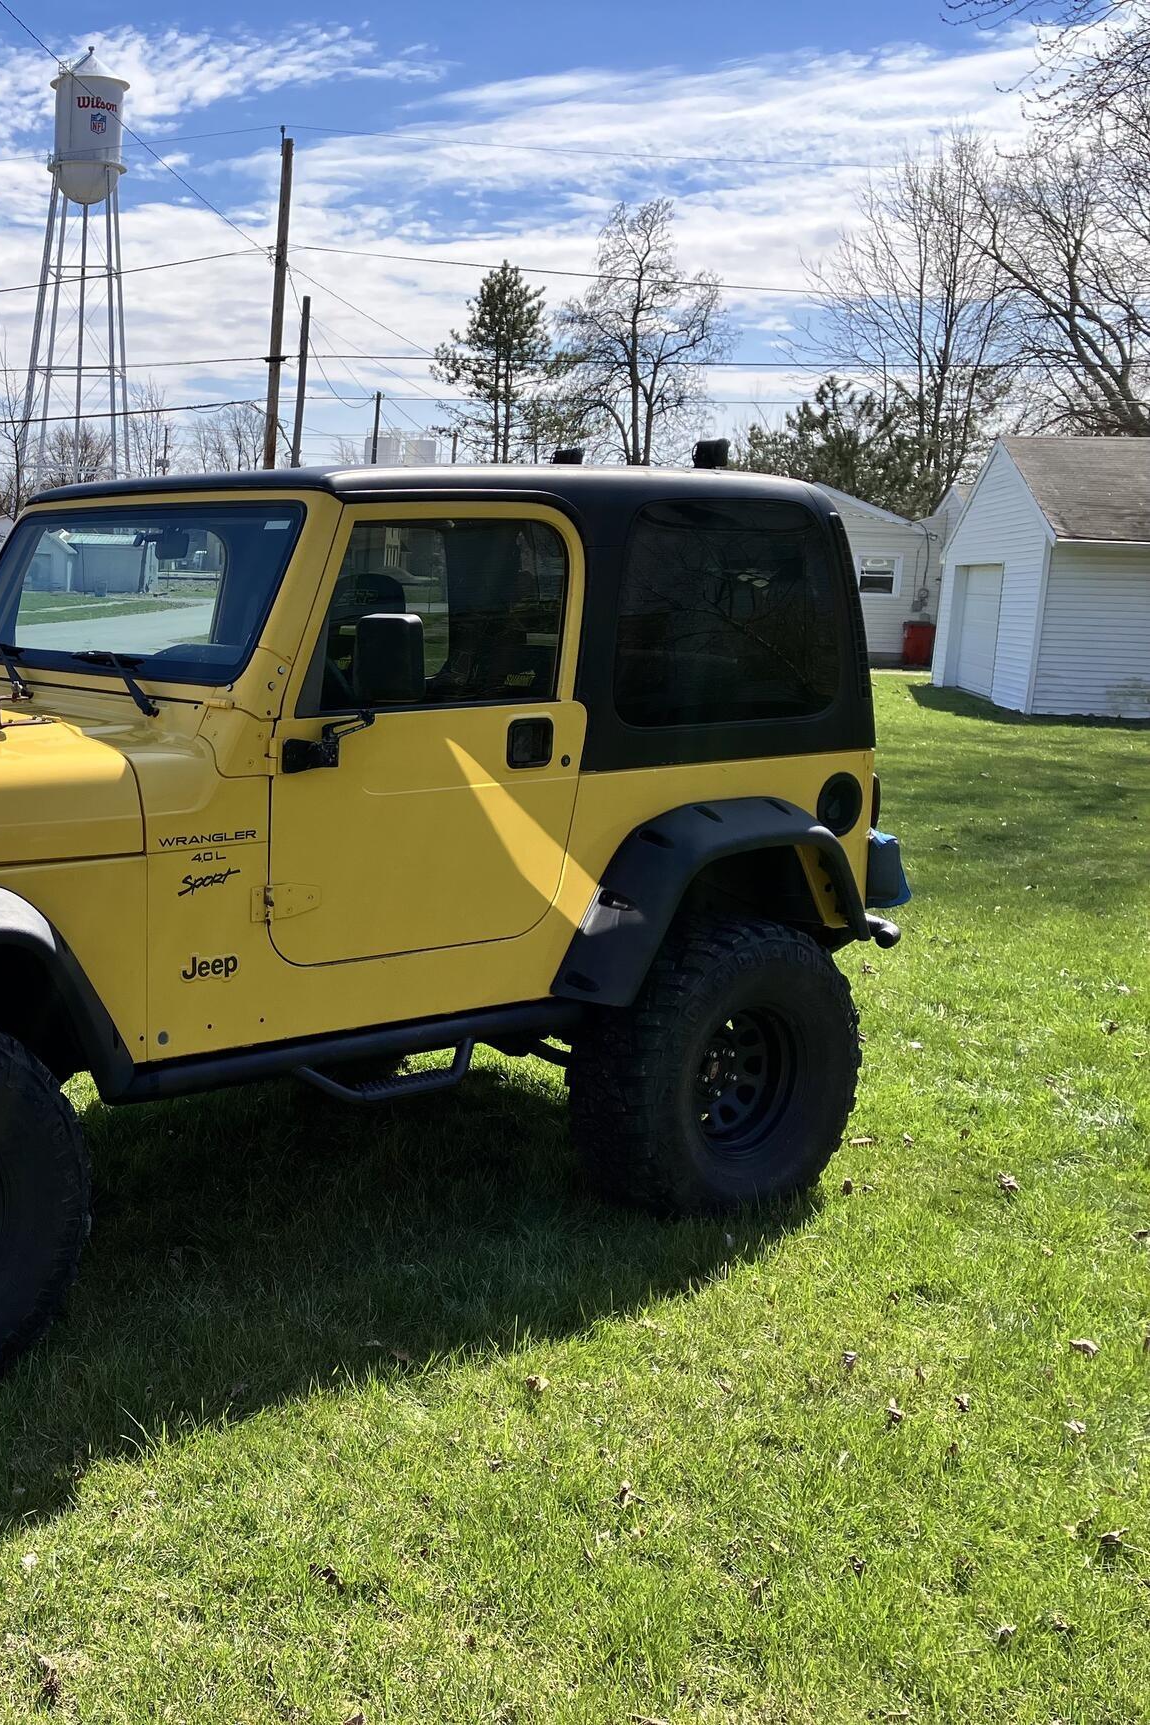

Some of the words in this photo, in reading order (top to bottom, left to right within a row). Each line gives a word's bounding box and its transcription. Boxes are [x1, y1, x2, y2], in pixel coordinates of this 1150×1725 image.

[76, 96, 118, 112] Wilson
[92, 122, 106, 132] NFL
[159, 830, 257, 847] WRANGLER
[177, 867, 241, 897] Sport
[182, 955, 238, 980] Jeep
